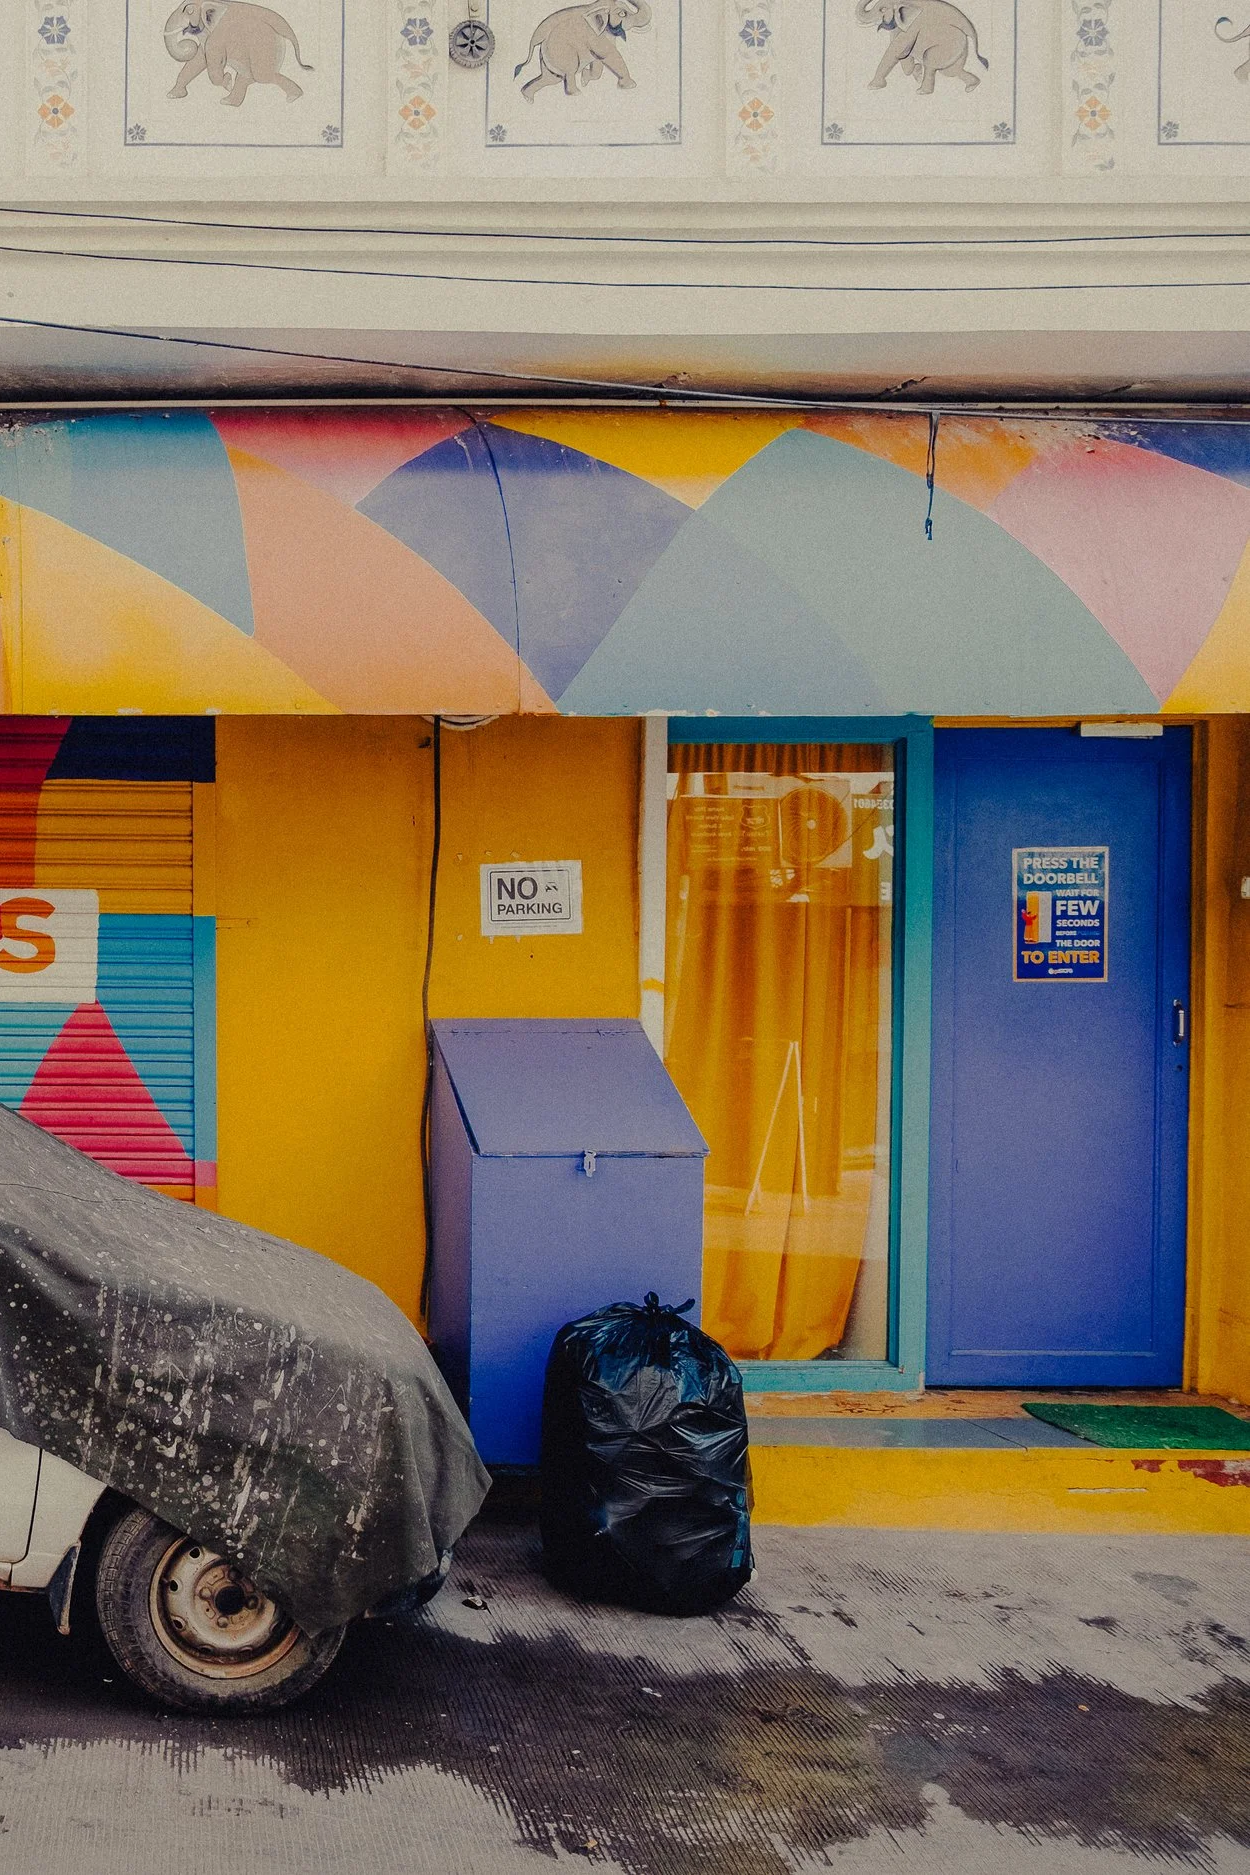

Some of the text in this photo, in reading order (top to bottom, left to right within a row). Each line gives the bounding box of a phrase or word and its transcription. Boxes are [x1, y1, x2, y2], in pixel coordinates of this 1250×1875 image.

[1022, 857, 1099, 869] PRESS THE
[1023, 872, 1099, 885] DOORBELL
[497, 876, 538, 900] NO
[1055, 889, 1100, 897] WAIT FOR
[497, 902, 563, 916] PARKING
[1055, 900, 1100, 916] FEW
[1056, 919, 1100, 927] SECONDS
[1055, 939, 1100, 947] THE DOOR
[1021, 951, 1100, 964] TO ENTER
